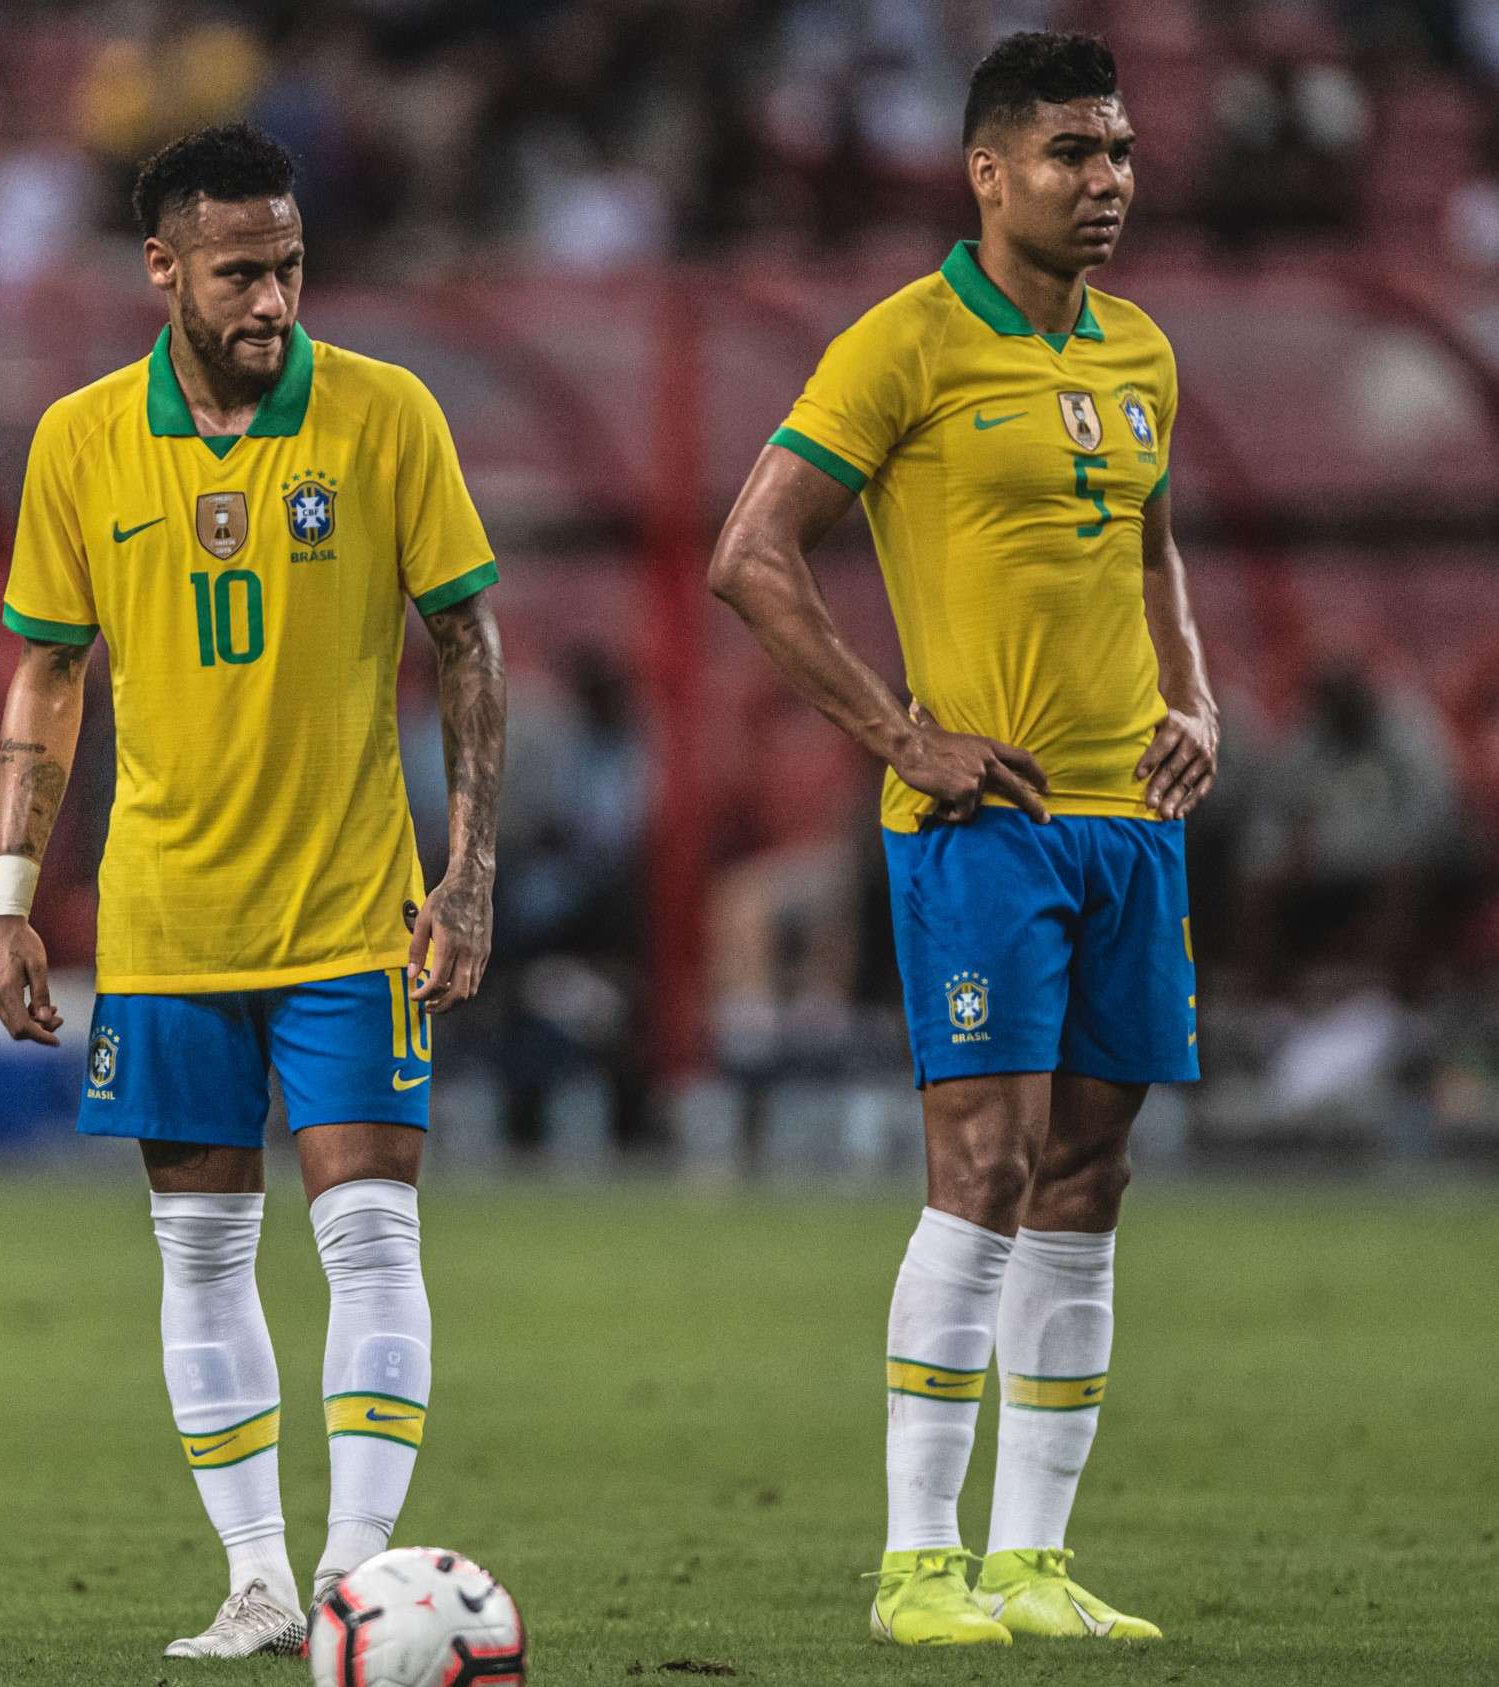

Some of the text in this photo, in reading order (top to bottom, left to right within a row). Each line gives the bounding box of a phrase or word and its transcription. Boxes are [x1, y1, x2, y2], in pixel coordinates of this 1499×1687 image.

[302, 508, 319, 516] CBF
[1073, 455, 1112, 538] 5
[291, 549, 337, 563] BRASIL
[190, 569, 265, 667] 10
[384, 966, 433, 1063] 10
[952, 1031, 991, 1043] BRASIL
